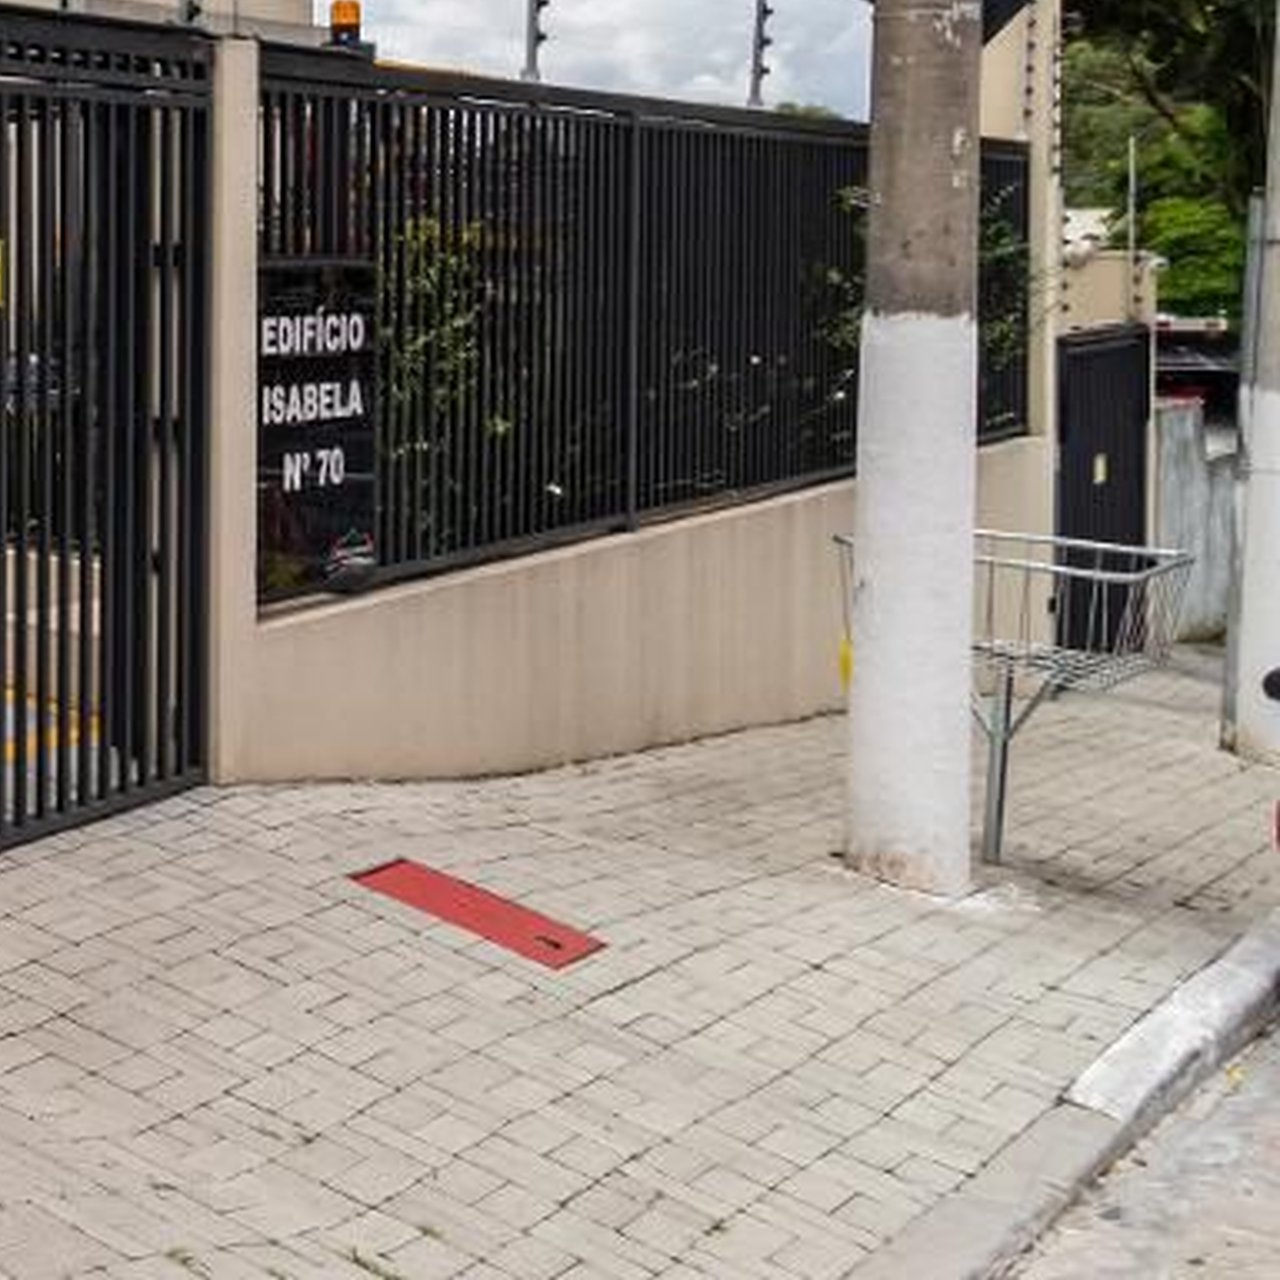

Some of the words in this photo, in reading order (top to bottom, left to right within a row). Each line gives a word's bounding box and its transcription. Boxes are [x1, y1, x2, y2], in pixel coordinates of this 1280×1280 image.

[261, 306, 365, 355] EDIFÍCIO
[262, 379, 363, 425] ISABELA
[316, 447, 344, 486] 70
